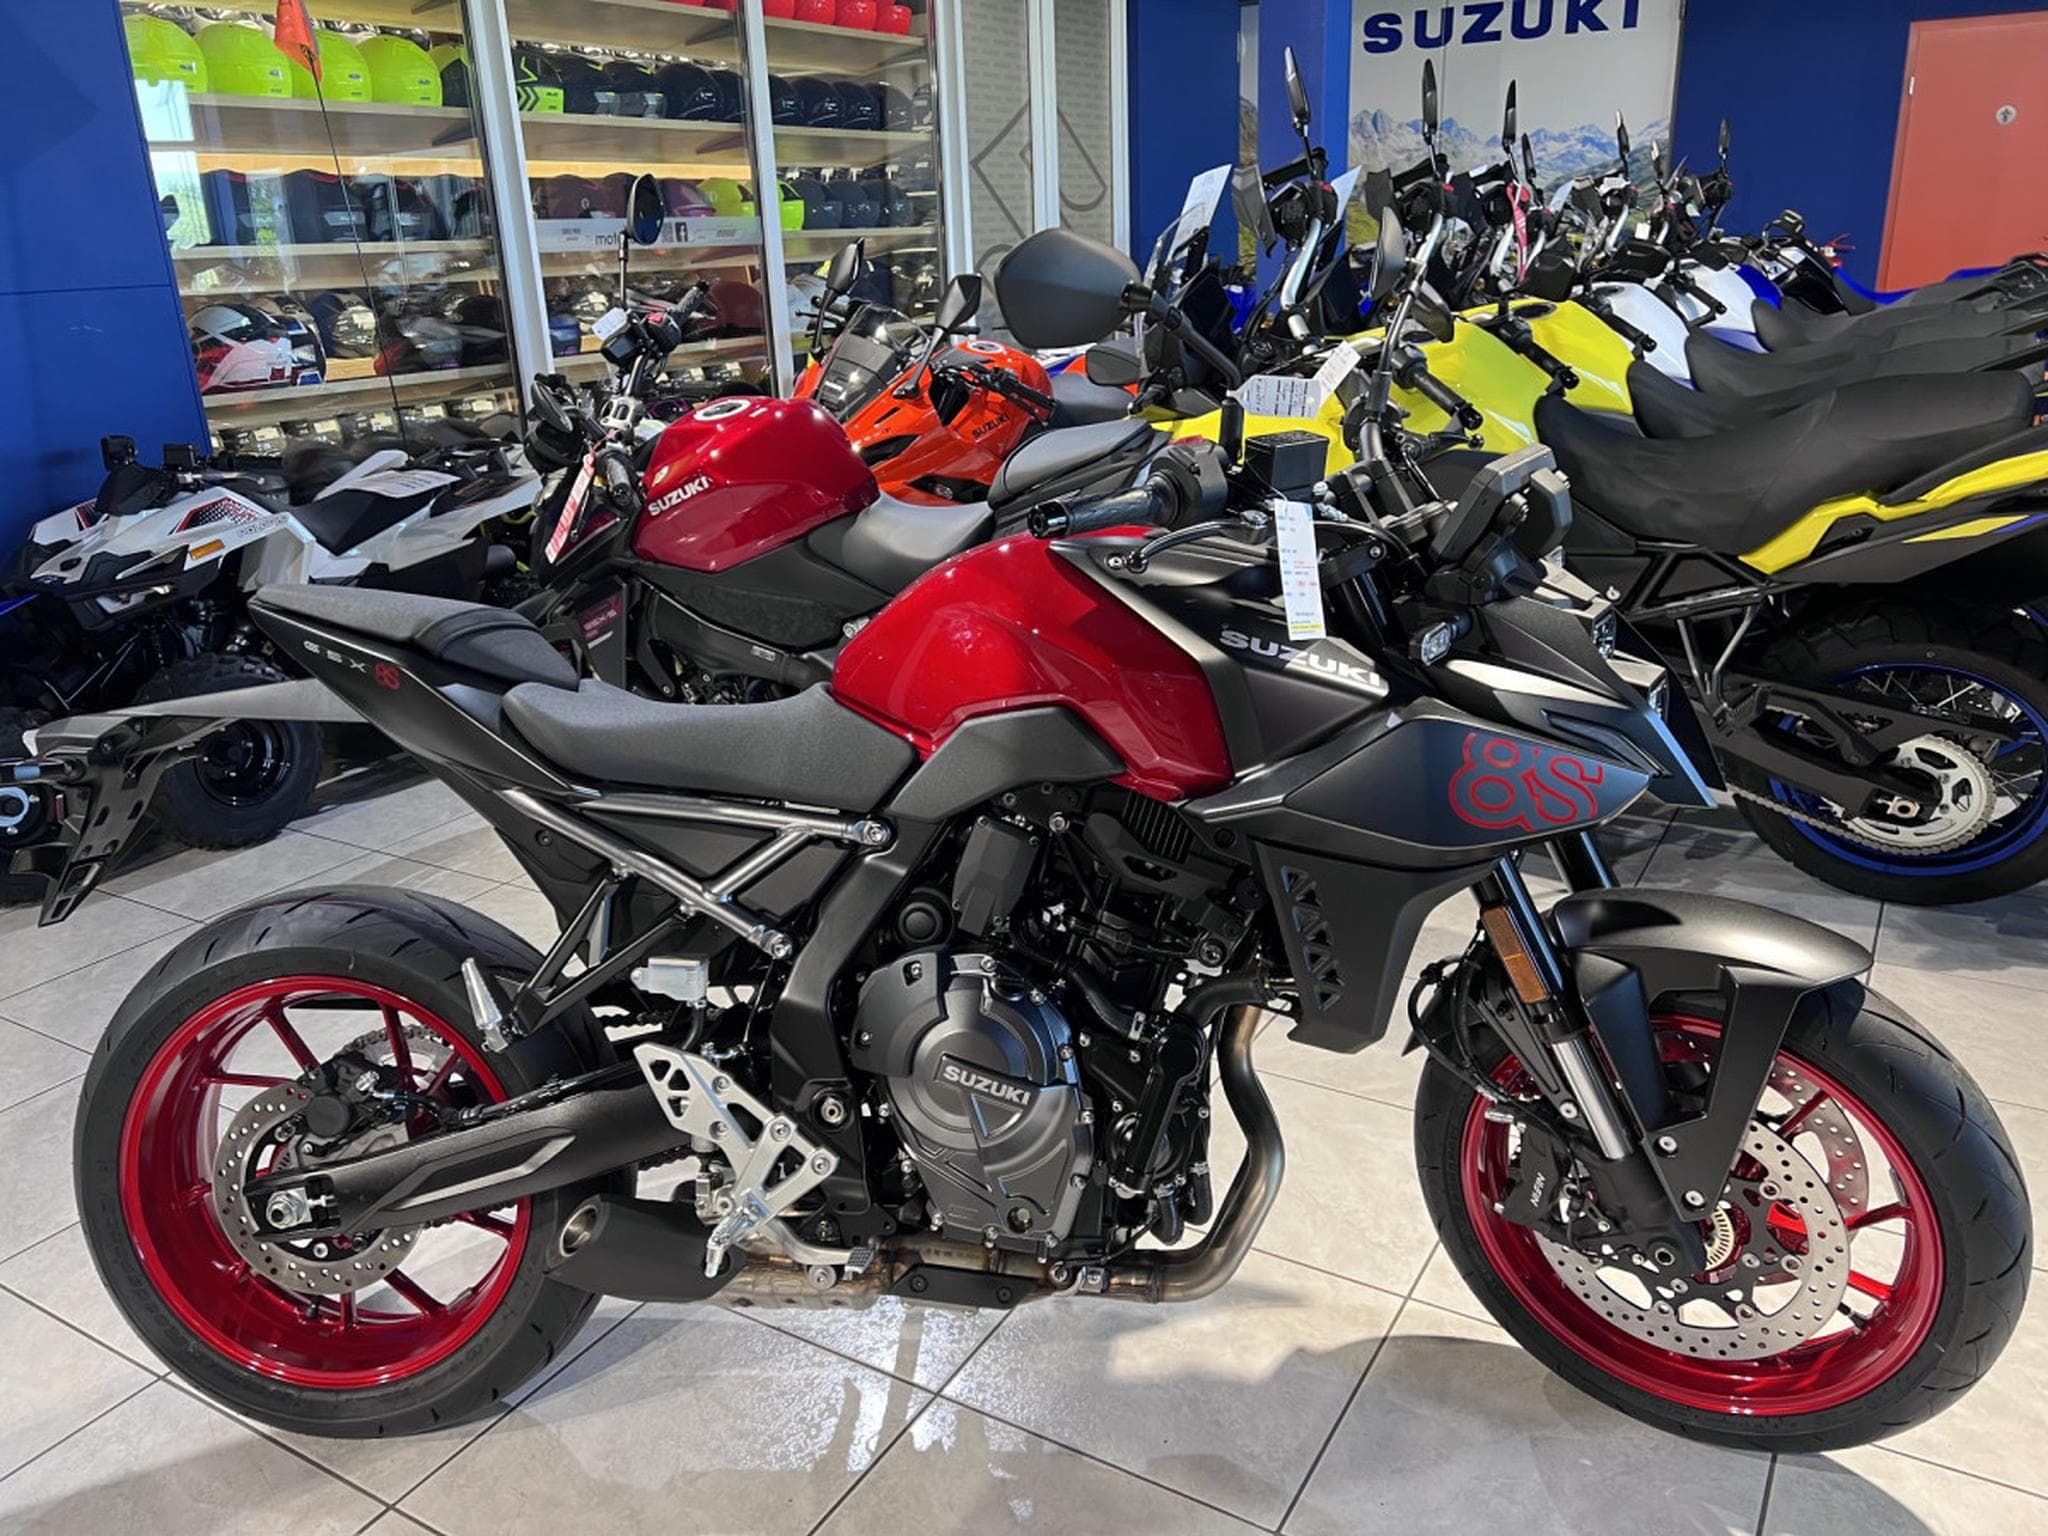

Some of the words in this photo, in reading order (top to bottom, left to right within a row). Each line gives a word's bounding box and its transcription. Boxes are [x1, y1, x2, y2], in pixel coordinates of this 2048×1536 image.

[1363, 0, 1640, 53] SUZUKI
[648, 475, 710, 517] SUZUKI
[1219, 629, 1381, 687] SUZUKI
[943, 1065, 1032, 1106] SUZUKI
